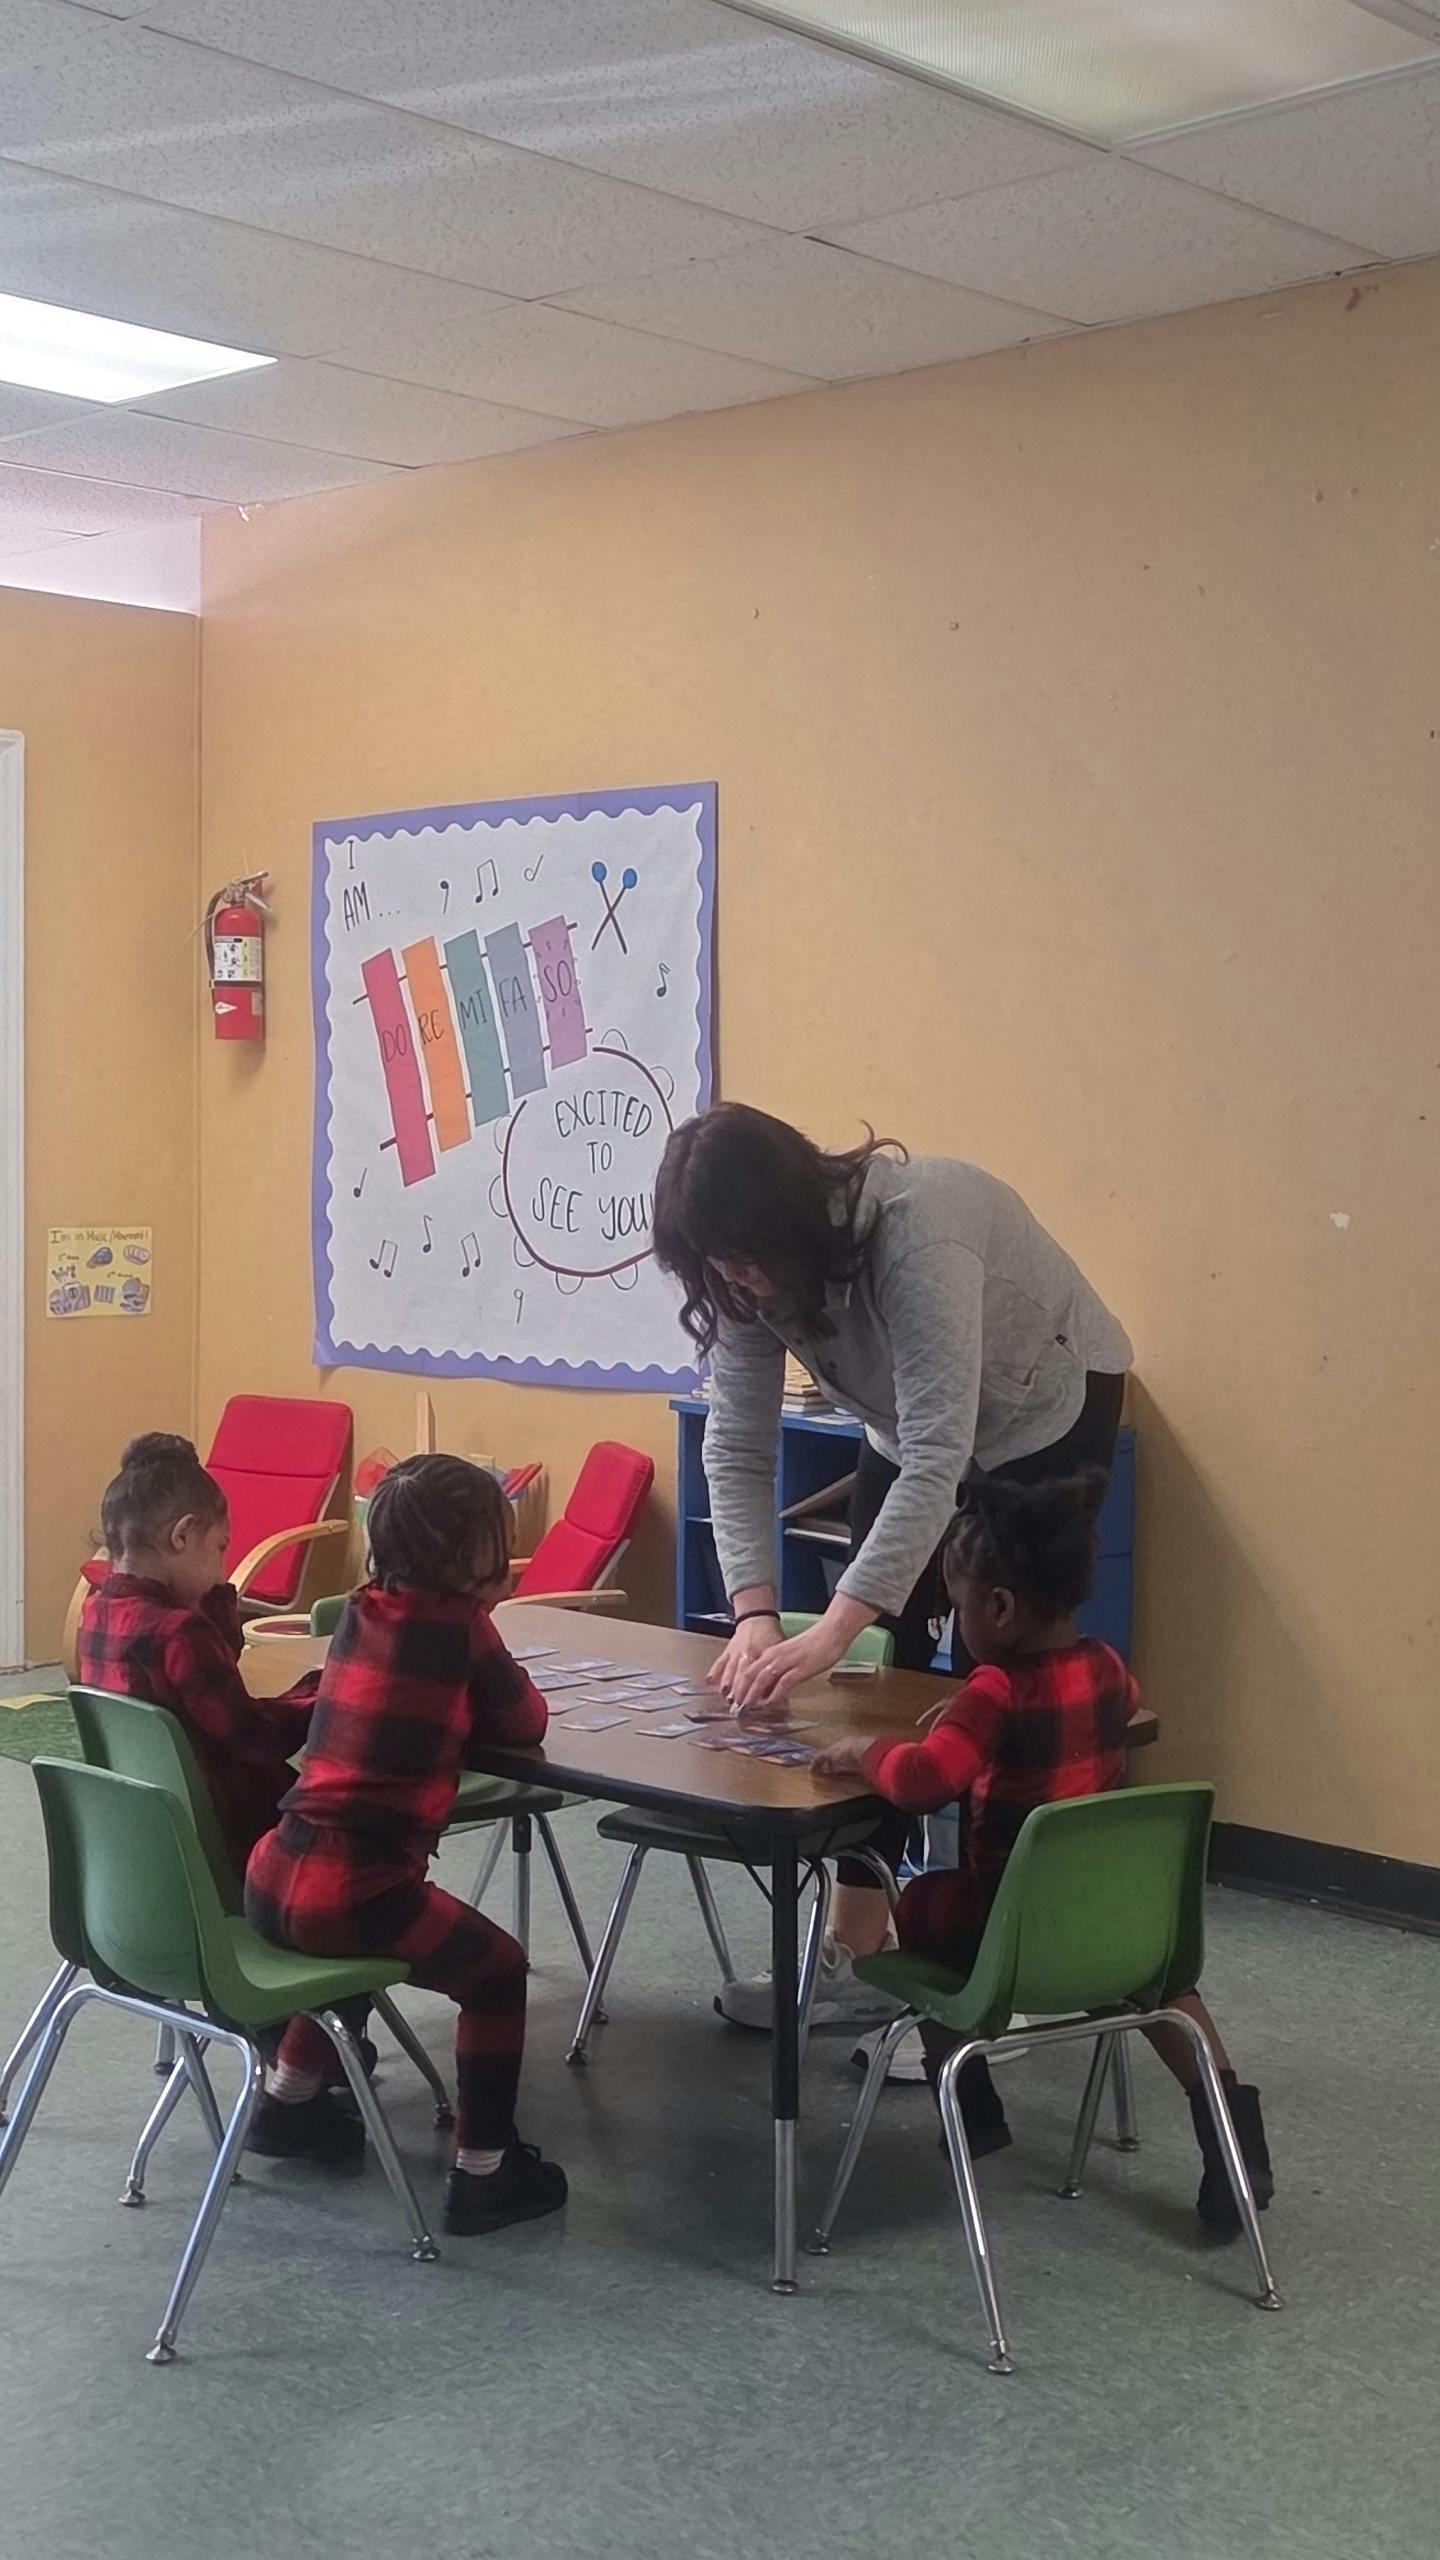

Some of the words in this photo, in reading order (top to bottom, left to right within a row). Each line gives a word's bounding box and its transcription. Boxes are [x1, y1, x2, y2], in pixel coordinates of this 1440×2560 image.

[347, 840, 355, 870] I
[343, 880, 400, 931] AM...
[382, 1023, 408, 1063] DO
[418, 1009, 445, 1045] RE
[459, 988, 488, 1030] MI
[498, 976, 528, 1018] FA
[543, 960, 573, 1003] SO
[555, 1090, 653, 1138] EXCITED
[586, 1141, 612, 1174] TO
[532, 1177, 583, 1233] SEE
